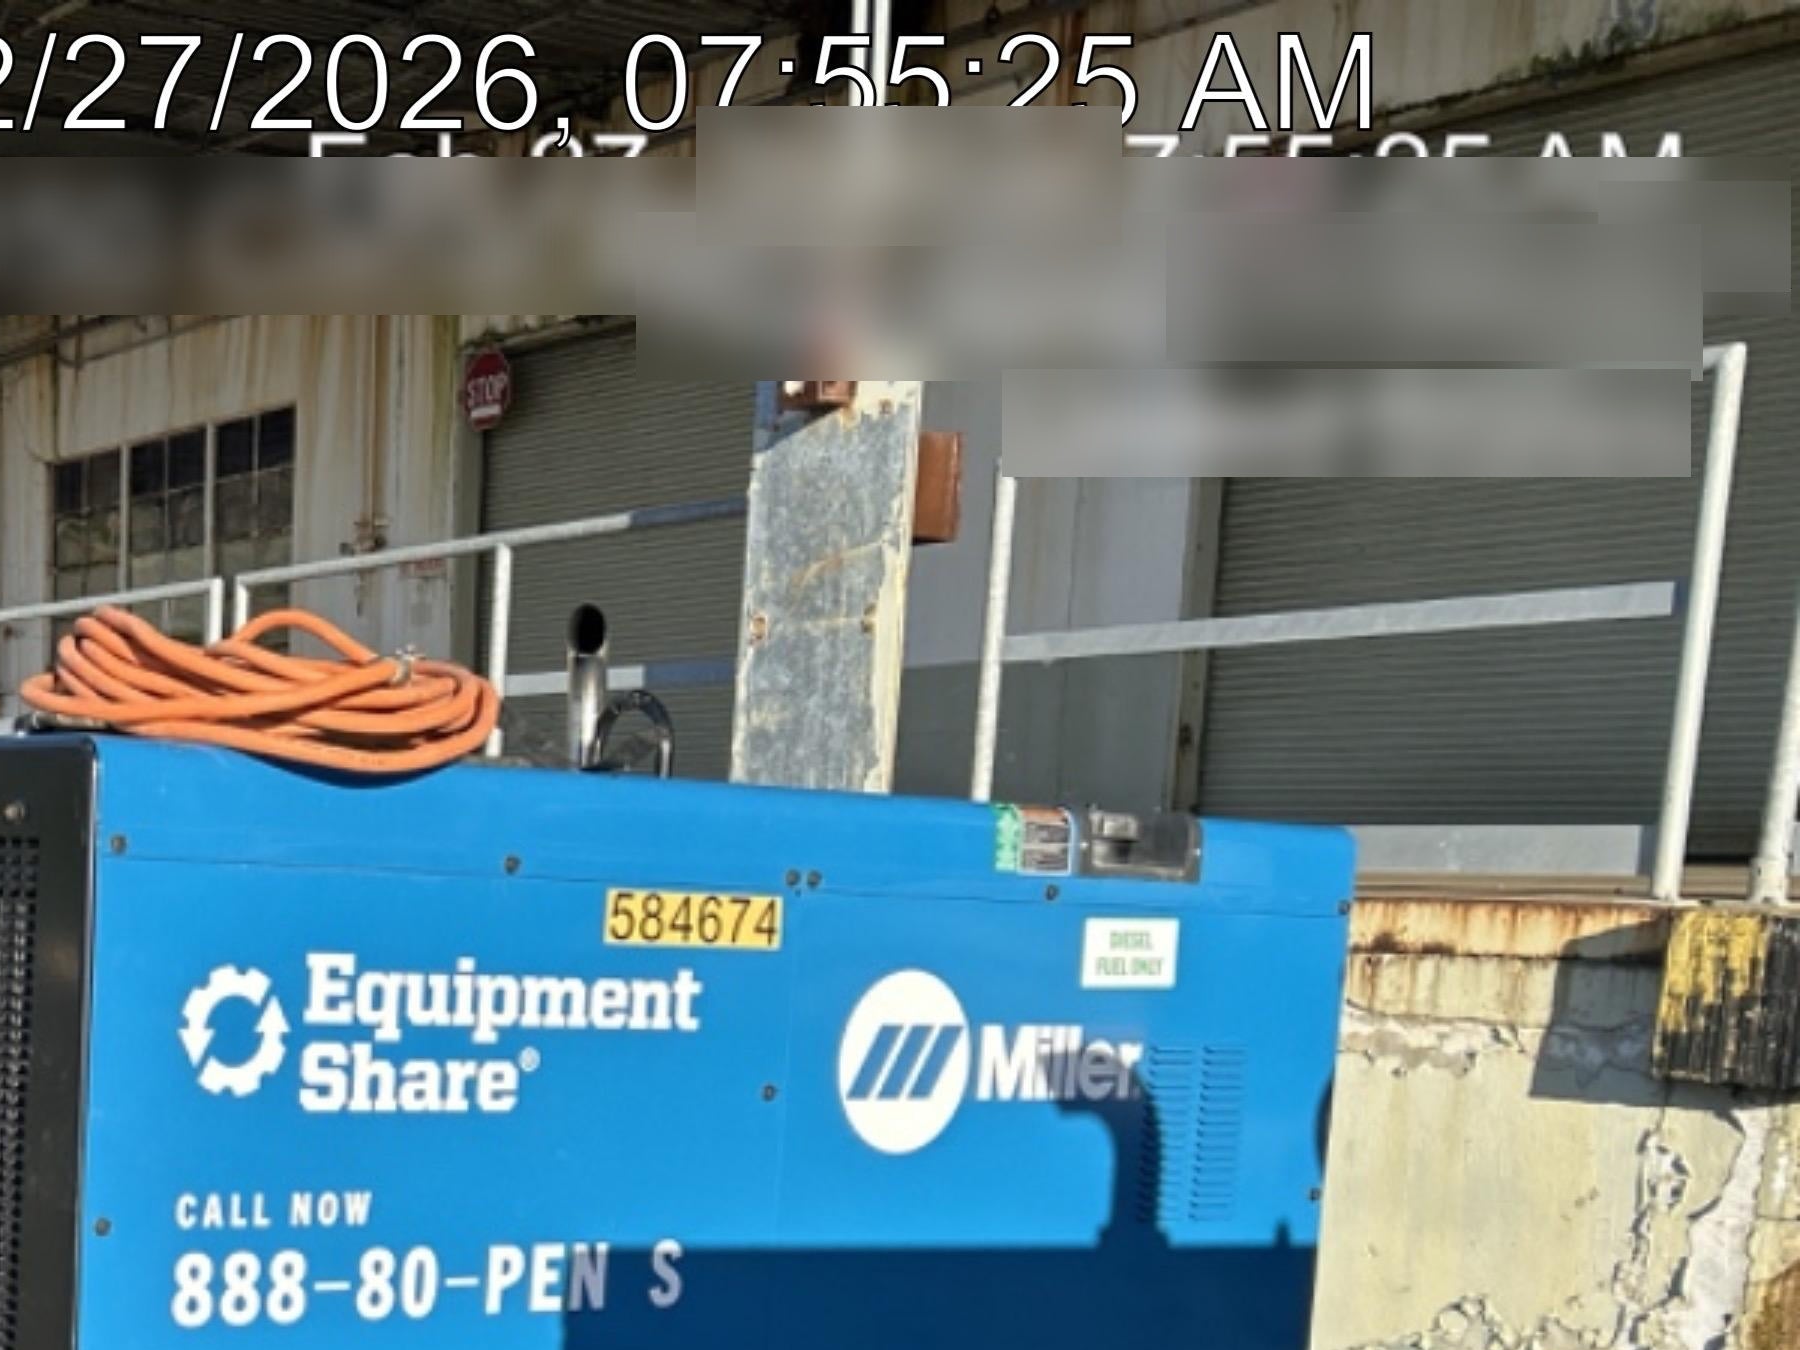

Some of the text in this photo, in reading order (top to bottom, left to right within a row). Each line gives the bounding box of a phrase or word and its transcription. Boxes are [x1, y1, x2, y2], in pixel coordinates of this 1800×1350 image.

[610, 891, 777, 946] 584674
[1109, 930, 1153, 950] DIESEL
[1095, 957, 1164, 976] FUEL ONLY
[302, 952, 703, 1044] Equipment
[977, 1023, 1144, 1100] Miller
[174, 1190, 374, 1230] CALL NOW
